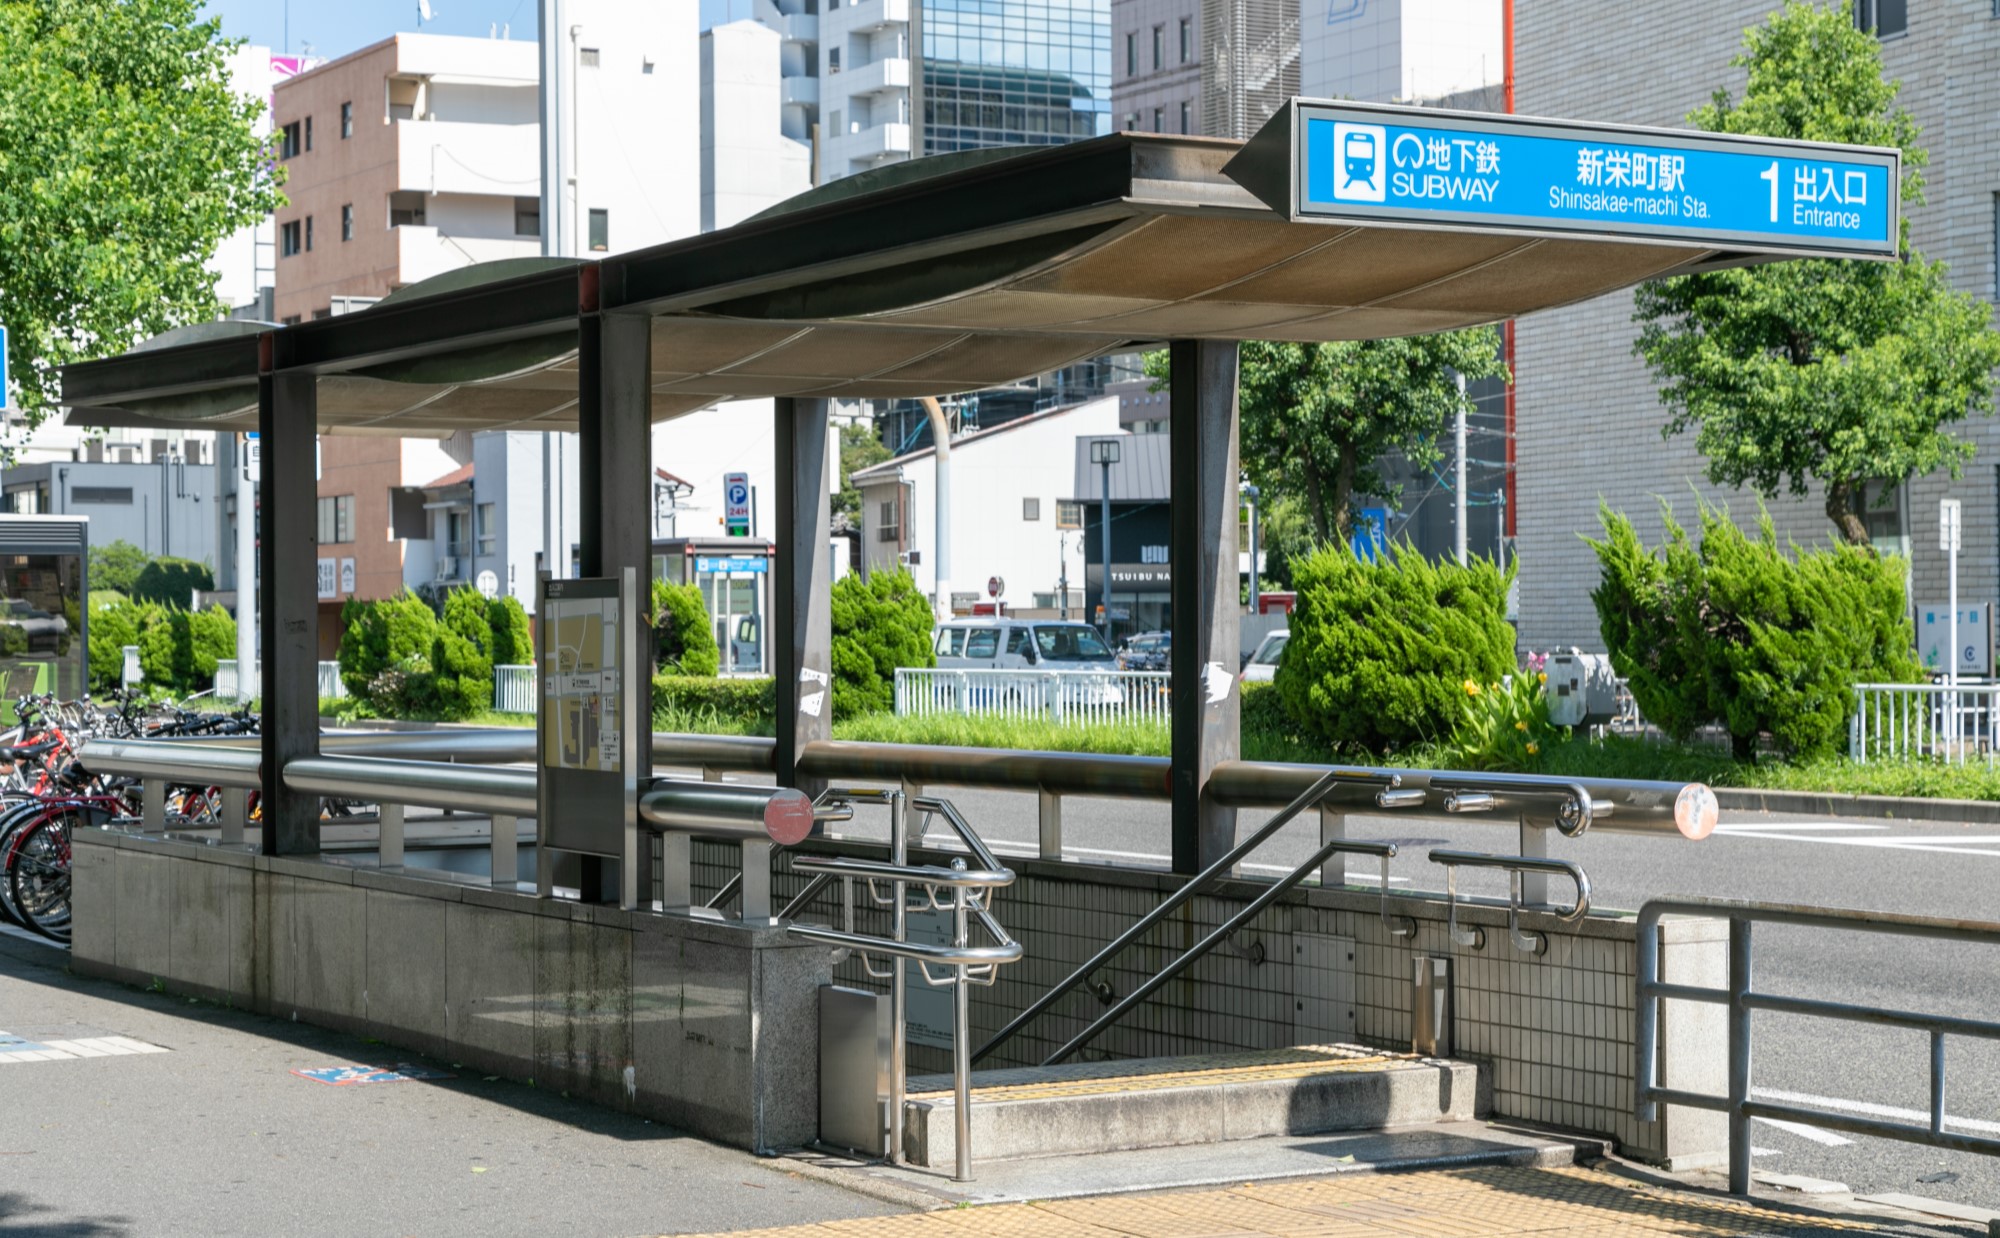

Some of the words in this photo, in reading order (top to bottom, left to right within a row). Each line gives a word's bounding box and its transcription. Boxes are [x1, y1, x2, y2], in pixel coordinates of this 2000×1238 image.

[1426, 136, 1501, 175] 地下鉄
[1576, 147, 1686, 192] 新栄町駅
[1391, 172, 1500, 203] SUBWAY
[1549, 185, 1679, 217] Shinsakae-machi
[1682, 195, 1711, 219] Sta.
[1760, 161, 1779, 223] 1
[1793, 165, 1867, 206] 出入口
[1793, 203, 1861, 230] Entrance
[729, 507, 749, 516] 24H
[1111, 572, 1153, 581] TSUIBU
